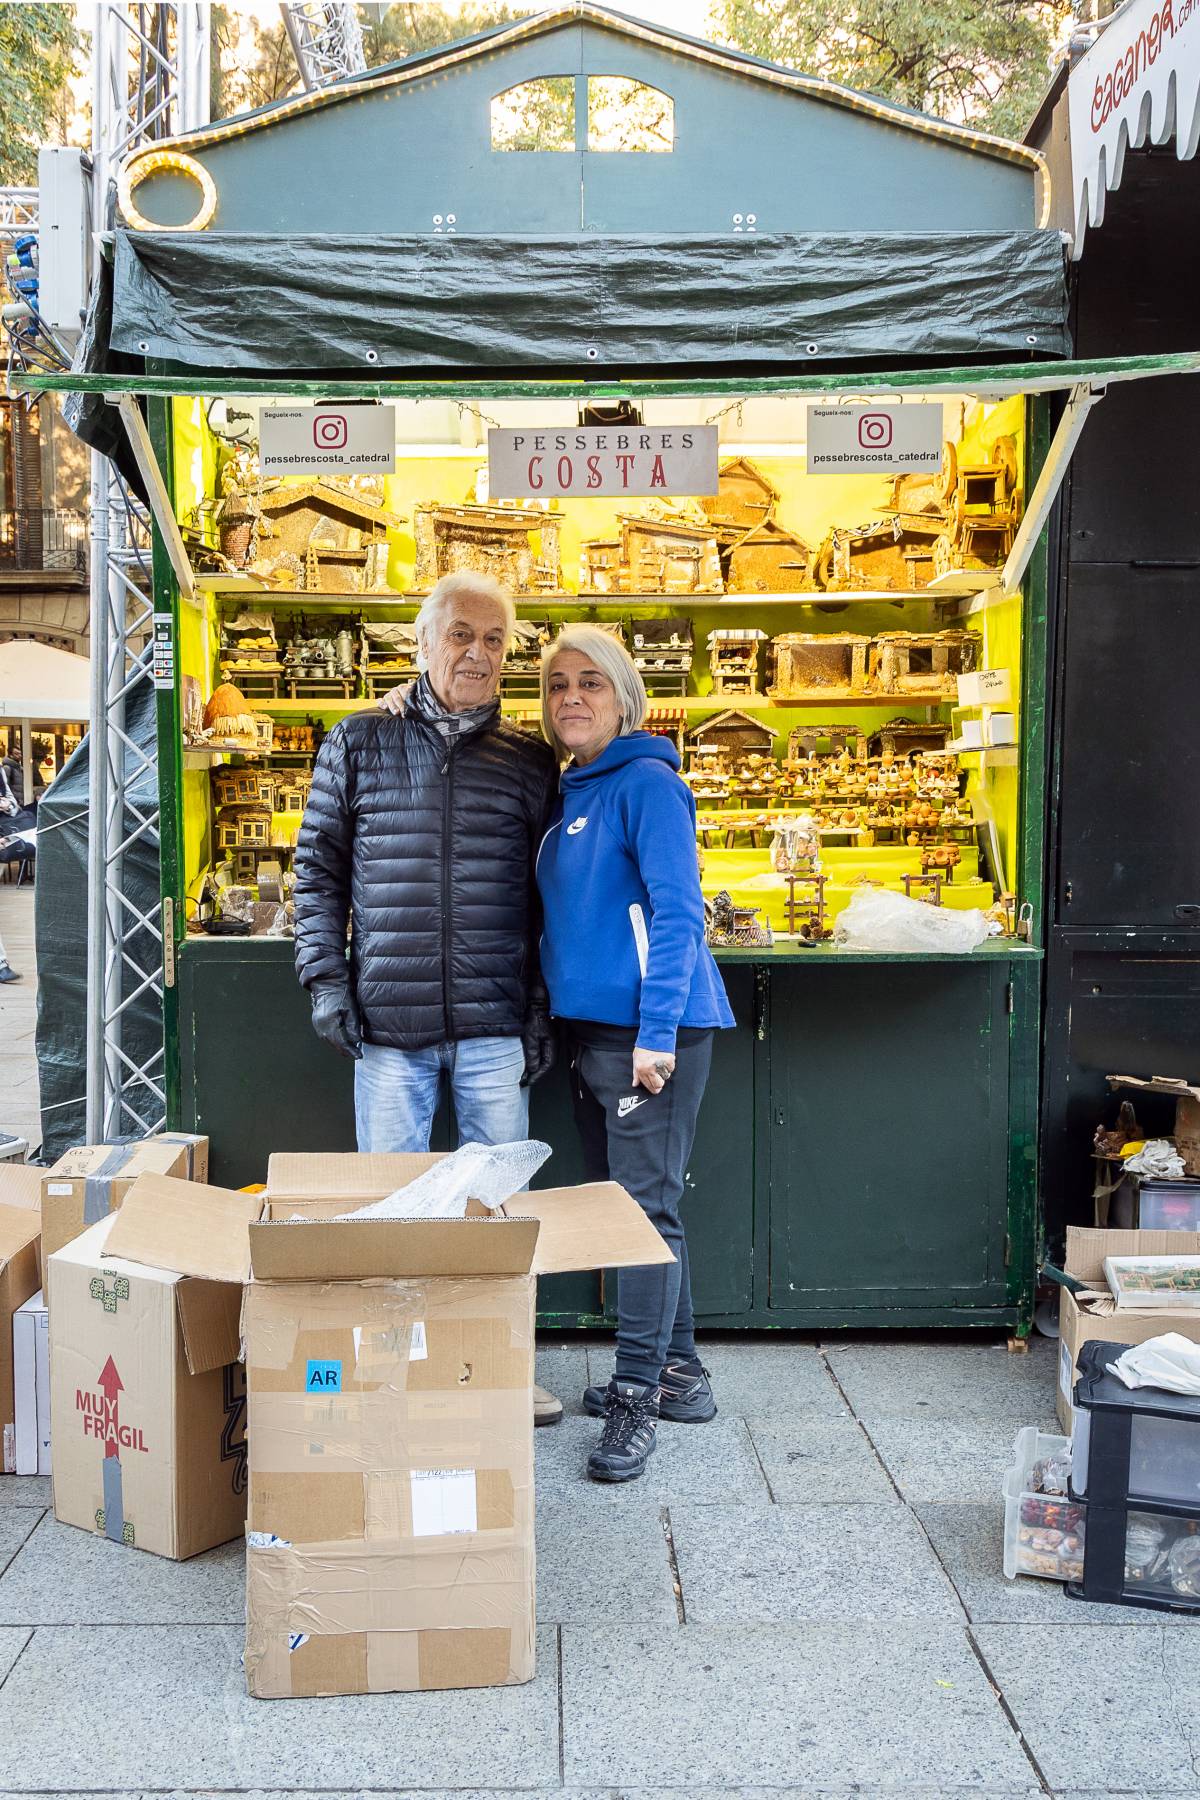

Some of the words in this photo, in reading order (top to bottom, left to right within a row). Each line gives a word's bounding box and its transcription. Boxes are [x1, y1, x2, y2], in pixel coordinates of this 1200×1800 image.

[512, 434, 694, 451] PESSEBRES
[264, 453, 390, 465] pessebrescosta_catedral
[813, 451, 939, 464] pessebrescosta_catedral
[528, 454, 668, 490] COSTA
[309, 1370, 338, 1386] AR
[76, 1389, 118, 1420] MUY
[84, 1414, 149, 1453] FRAGIL
